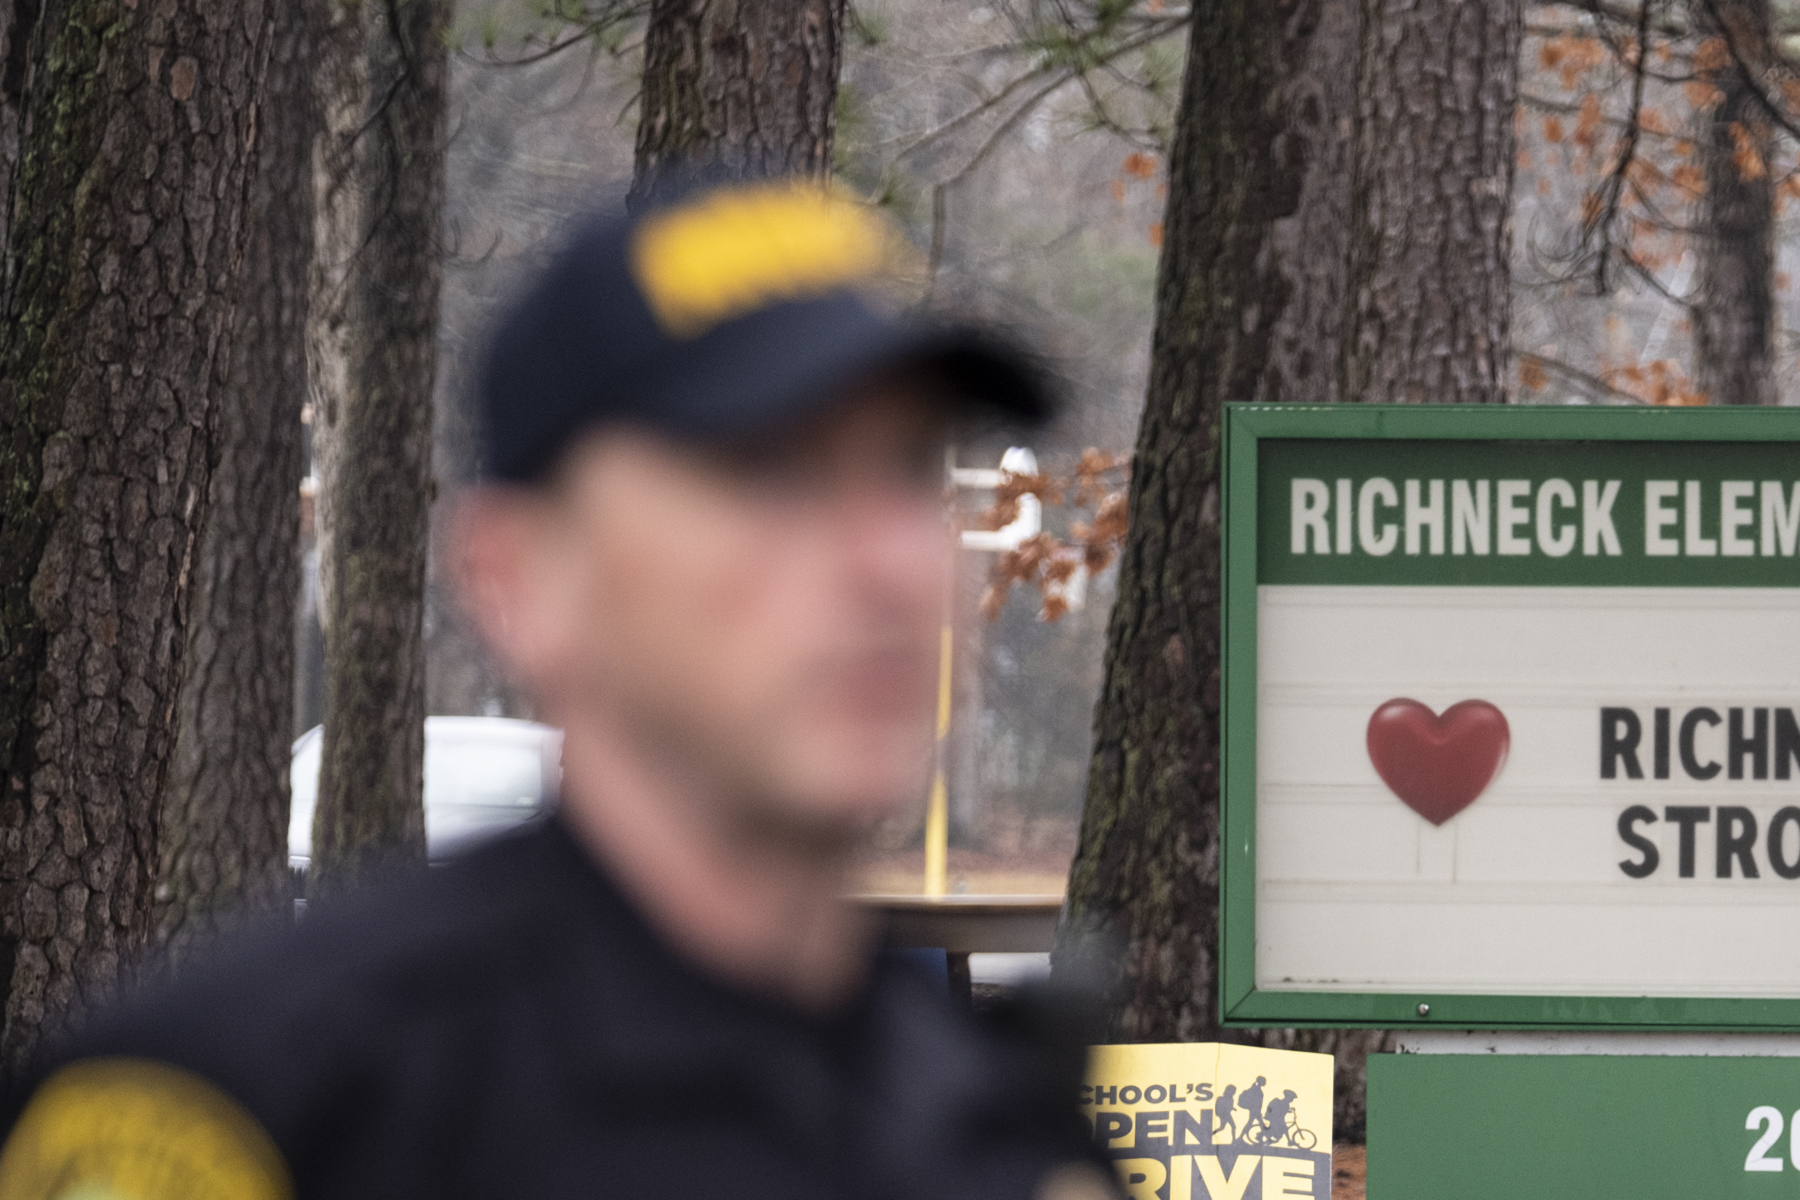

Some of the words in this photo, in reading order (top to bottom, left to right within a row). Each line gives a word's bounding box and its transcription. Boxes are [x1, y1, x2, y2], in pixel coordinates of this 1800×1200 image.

[1290, 477, 1623, 557] RICHNECK
[1078, 1082, 1214, 1106] CHOOL'S
[1094, 1108, 1214, 1149] PEN
